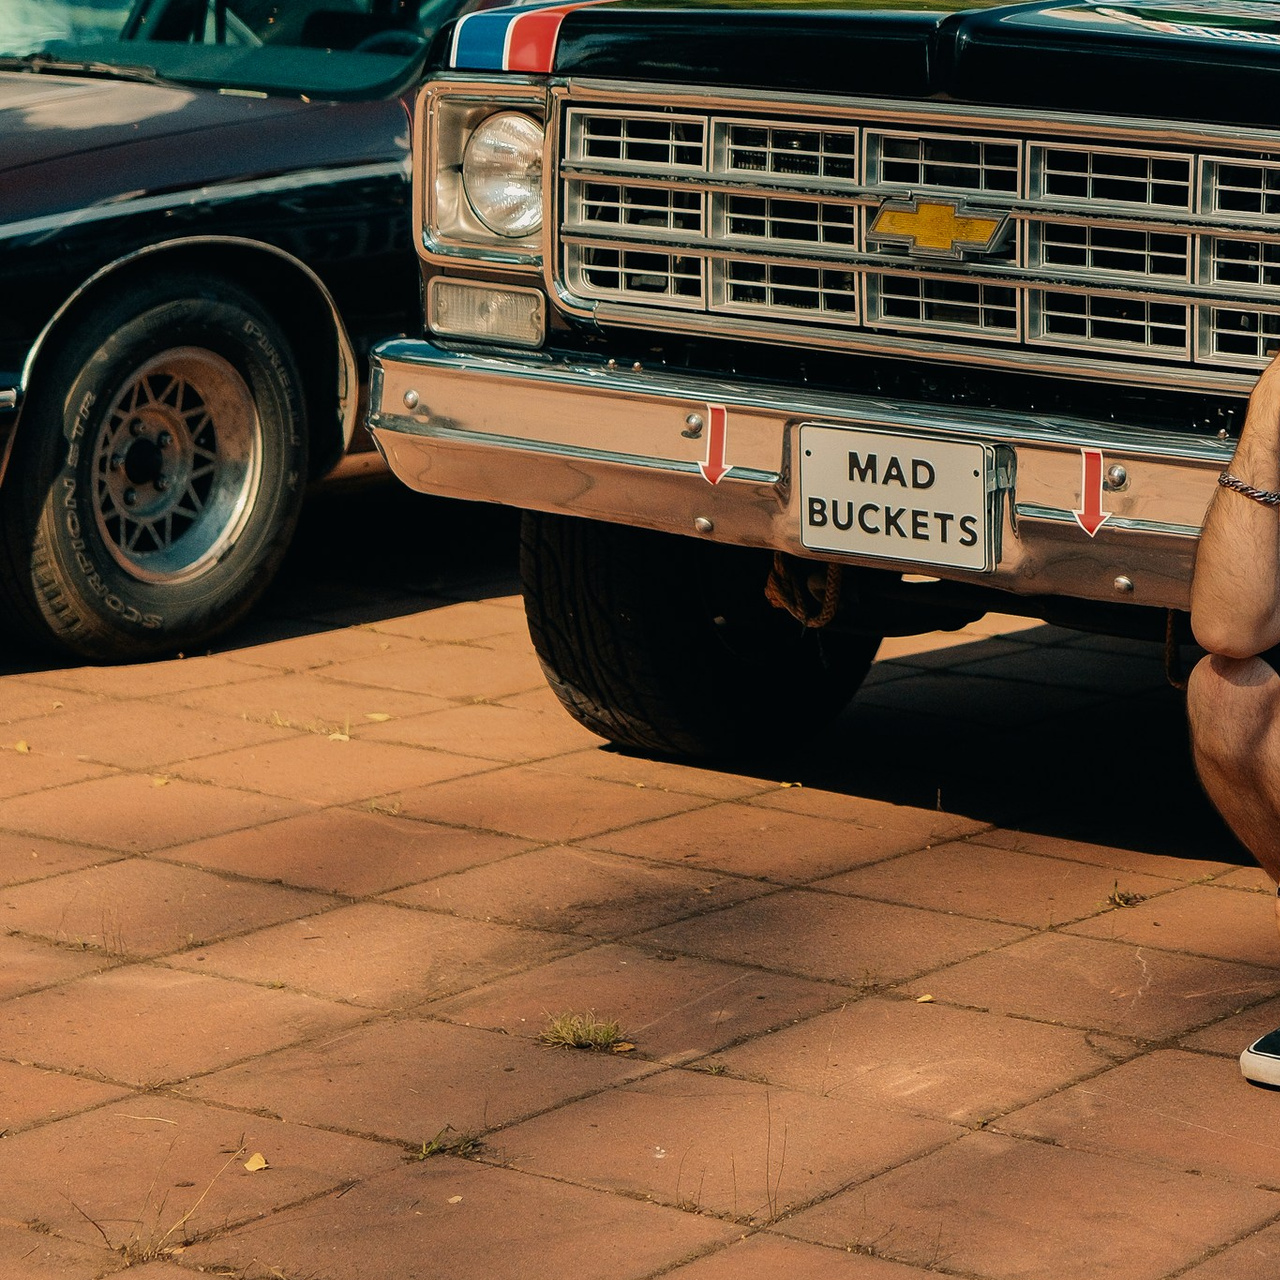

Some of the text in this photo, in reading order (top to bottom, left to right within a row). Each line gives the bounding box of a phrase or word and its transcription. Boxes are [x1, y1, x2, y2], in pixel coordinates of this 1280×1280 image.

[848, 451, 936, 489] MAD
[62, 390, 164, 631] SCORPION STR
[808, 496, 978, 547] BUCKETS
